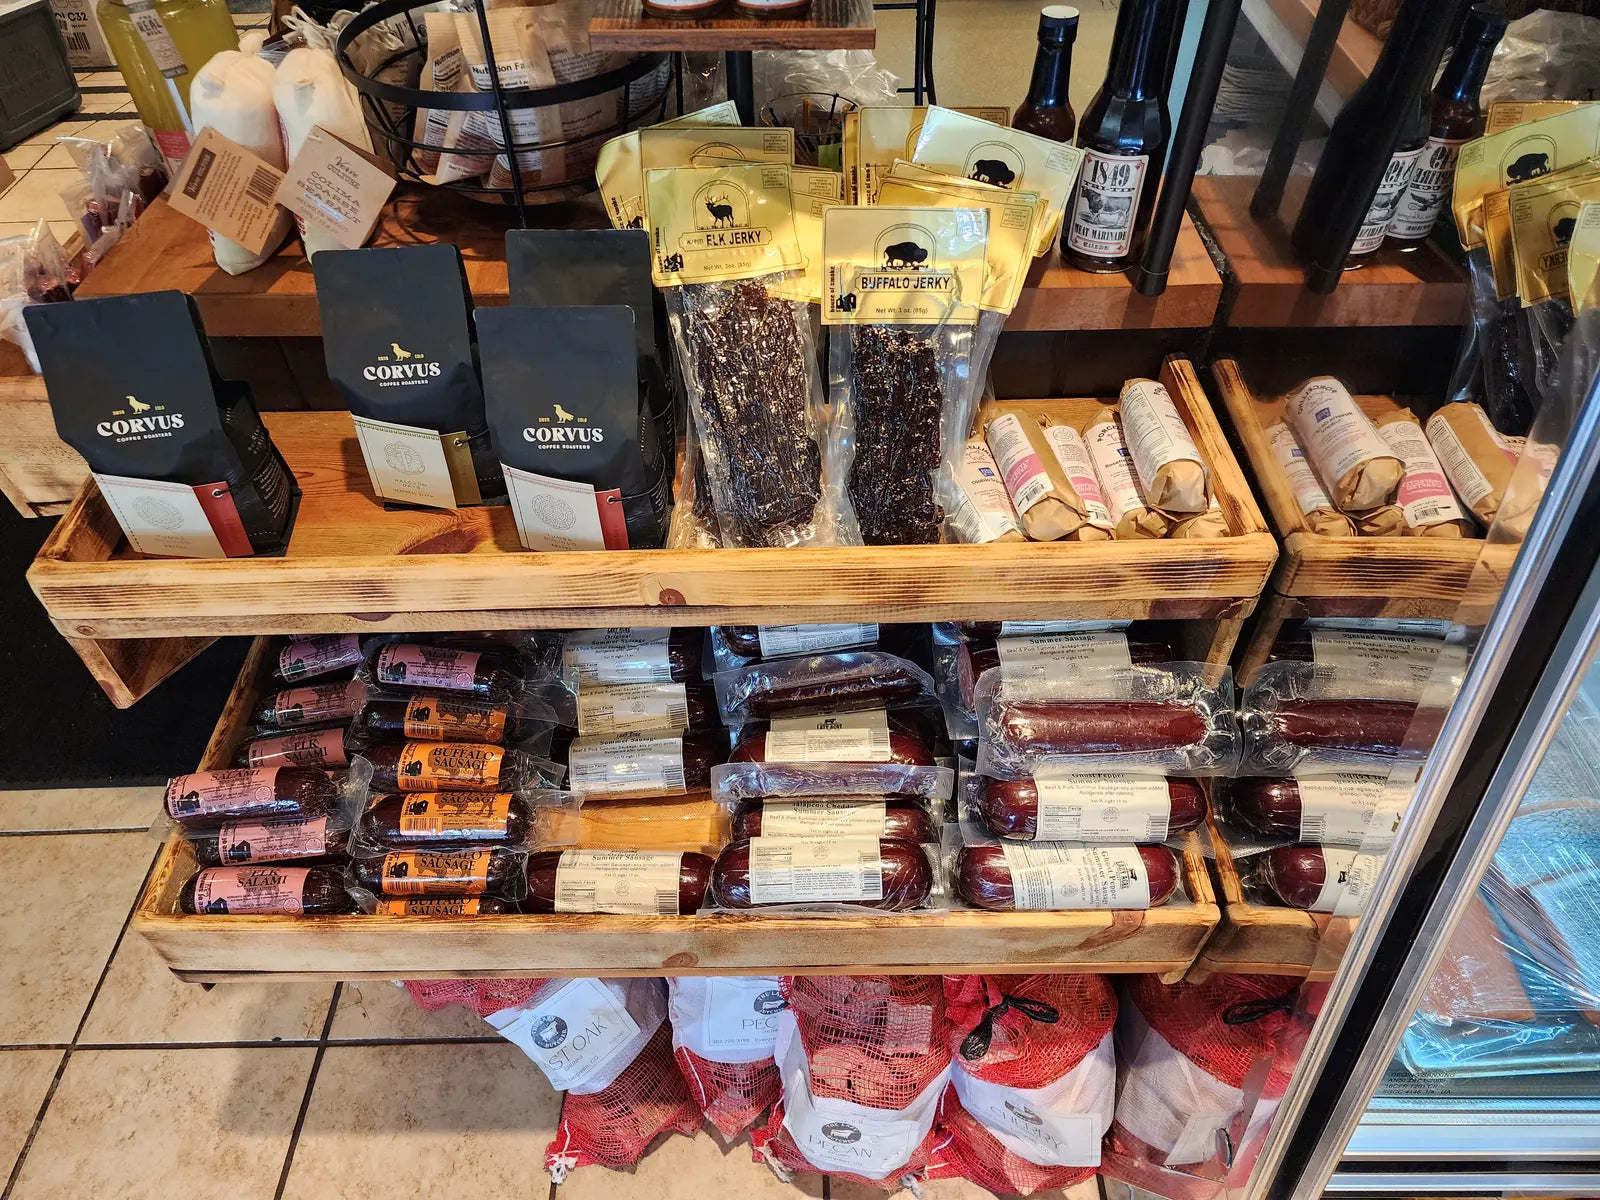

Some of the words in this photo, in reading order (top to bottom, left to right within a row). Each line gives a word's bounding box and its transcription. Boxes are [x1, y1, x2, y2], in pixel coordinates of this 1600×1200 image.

[1091, 159, 1131, 187] 1849
[1083, 179, 1136, 193] TRI-TIP
[306, 177, 359, 214] COARSE
[1075, 222, 1089, 237] MEAT
[1092, 229, 1128, 241] MARINADE
[705, 233, 727, 248] ELK
[728, 230, 761, 246] JERKY
[861, 276, 910, 290] BUFFALO
[913, 276, 951, 290] JERKY
[363, 362, 441, 381] CORVUS
[96, 413, 185, 437] CORVUS
[143, 432, 172, 440] ROASTERS
[522, 427, 604, 442] CORVUS
[1029, 637, 1062, 645] Summer
[1064, 634, 1096, 642] Sausage
[294, 739, 320, 751] ELK
[600, 738, 628, 746] Summer
[285, 747, 329, 763] SALAMI
[433, 747, 495, 761] BUFFALO
[433, 758, 489, 771] SAUSAGE
[210, 769, 260, 781] SALAMI
[440, 794, 498, 804] SAUSAGE
[420, 857, 477, 871] SAUSAGE
[1092, 846, 1105, 879] Summer
[236, 875, 288, 888] SALAMI
[1100, 850, 1112, 874] Ghost
[1109, 875, 1118, 900] Pepper
[742, 1016, 779, 1030] PEC
[572, 1016, 607, 1051] OAK
[808, 1134, 873, 1159] PECAN
